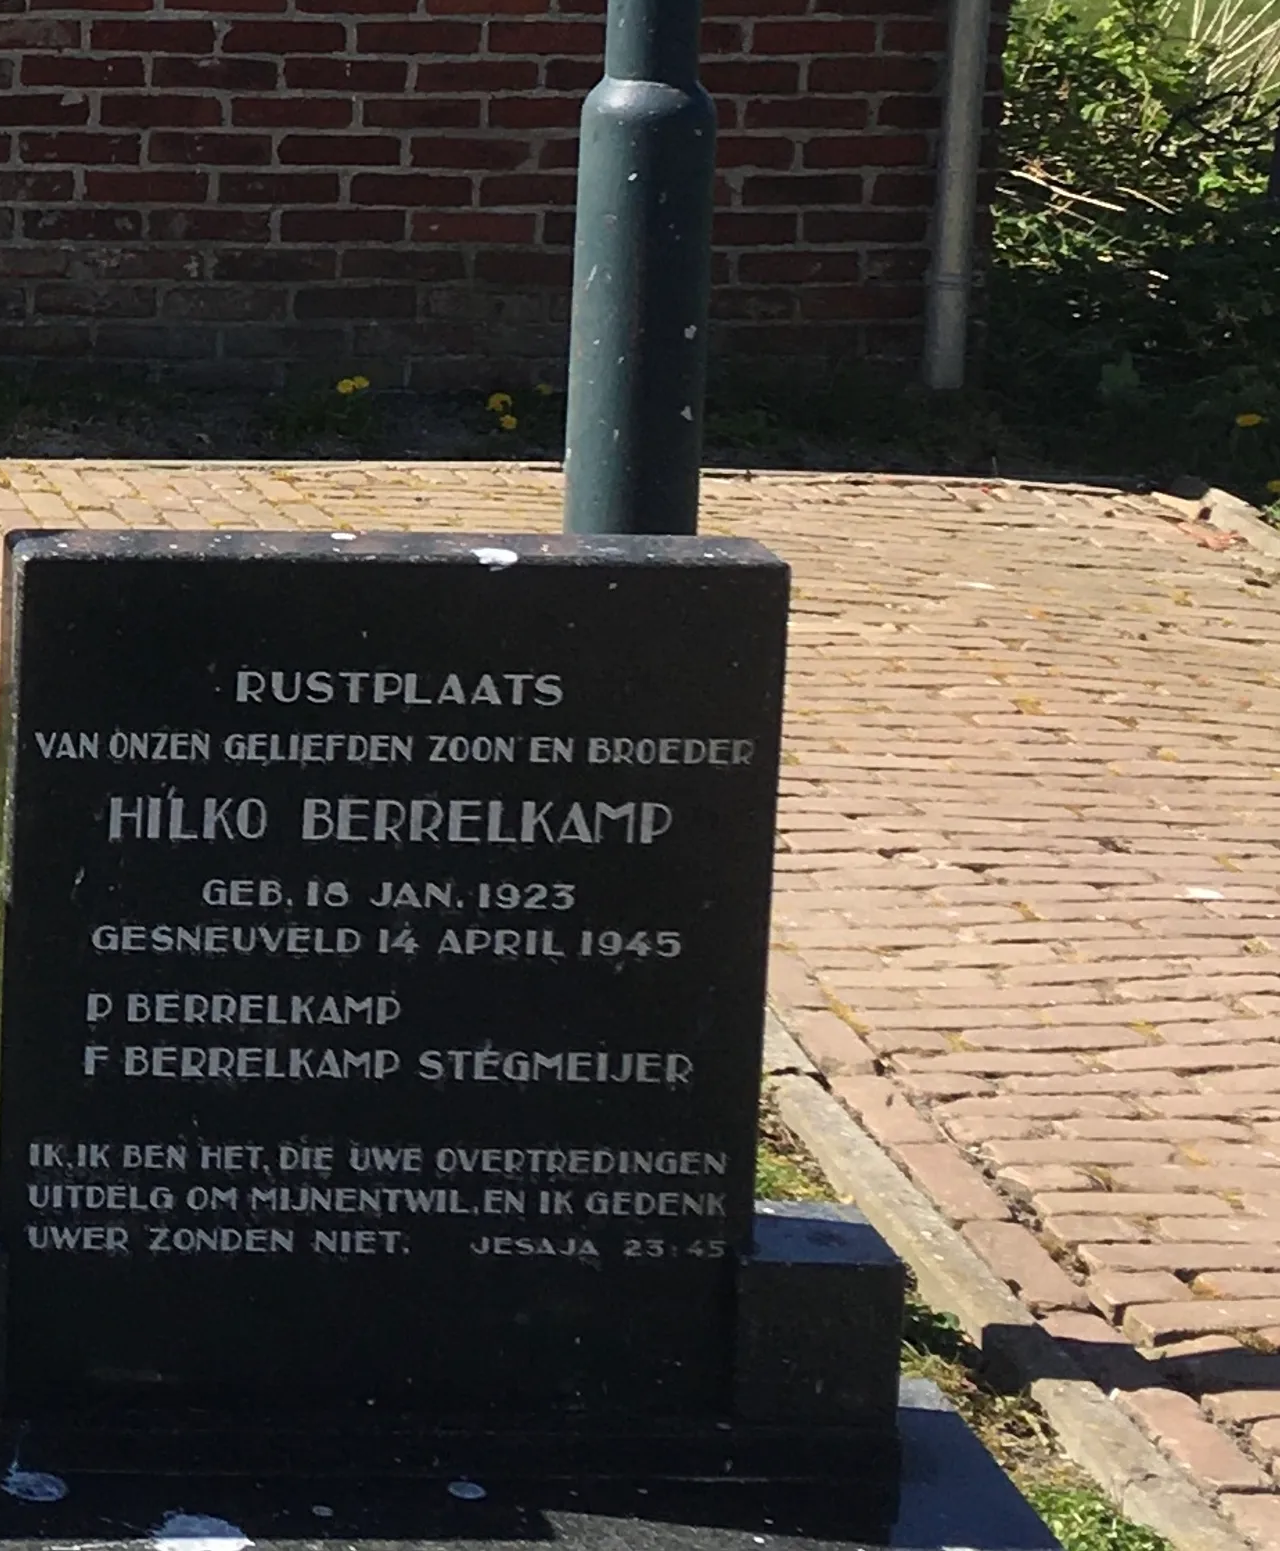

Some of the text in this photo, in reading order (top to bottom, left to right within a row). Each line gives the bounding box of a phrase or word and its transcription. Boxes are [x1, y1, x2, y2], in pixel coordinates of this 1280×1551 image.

[235, 670, 565, 708] RUSTPLAATS
[34, 730, 755, 766] VAN ONZEN GELIEFDEN ZOON EN BROEDER
[108, 796, 674, 845] HILKO BERRELKAMP
[201, 879, 577, 911] GEB. 18 JAN. 1923
[91, 924, 683, 959] GESNEUVELD 14 APRIL 1945
[126, 993, 402, 1026] BERRELKAMP
[83, 1045, 111, 1076] F
[123, 1045, 401, 1080] BERRELKAMP
[76, 1143, 111, 1169] IK
[122, 1144, 187, 1171] BEN
[278, 1146, 334, 1172] DIE
[347, 1146, 423, 1173] UWE
[435, 1147, 728, 1176] OVERTREDINGEN
[27, 1183, 176, 1211] UITDELG
[185, 1185, 239, 1211] OM
[483, 1189, 525, 1214] EN
[538, 1190, 575, 1215] IK
[584, 1190, 728, 1217] GEDENK
[27, 1225, 411, 1256] UWER ZONDEN NIET.
[469, 1235, 600, 1258] JESAJA
